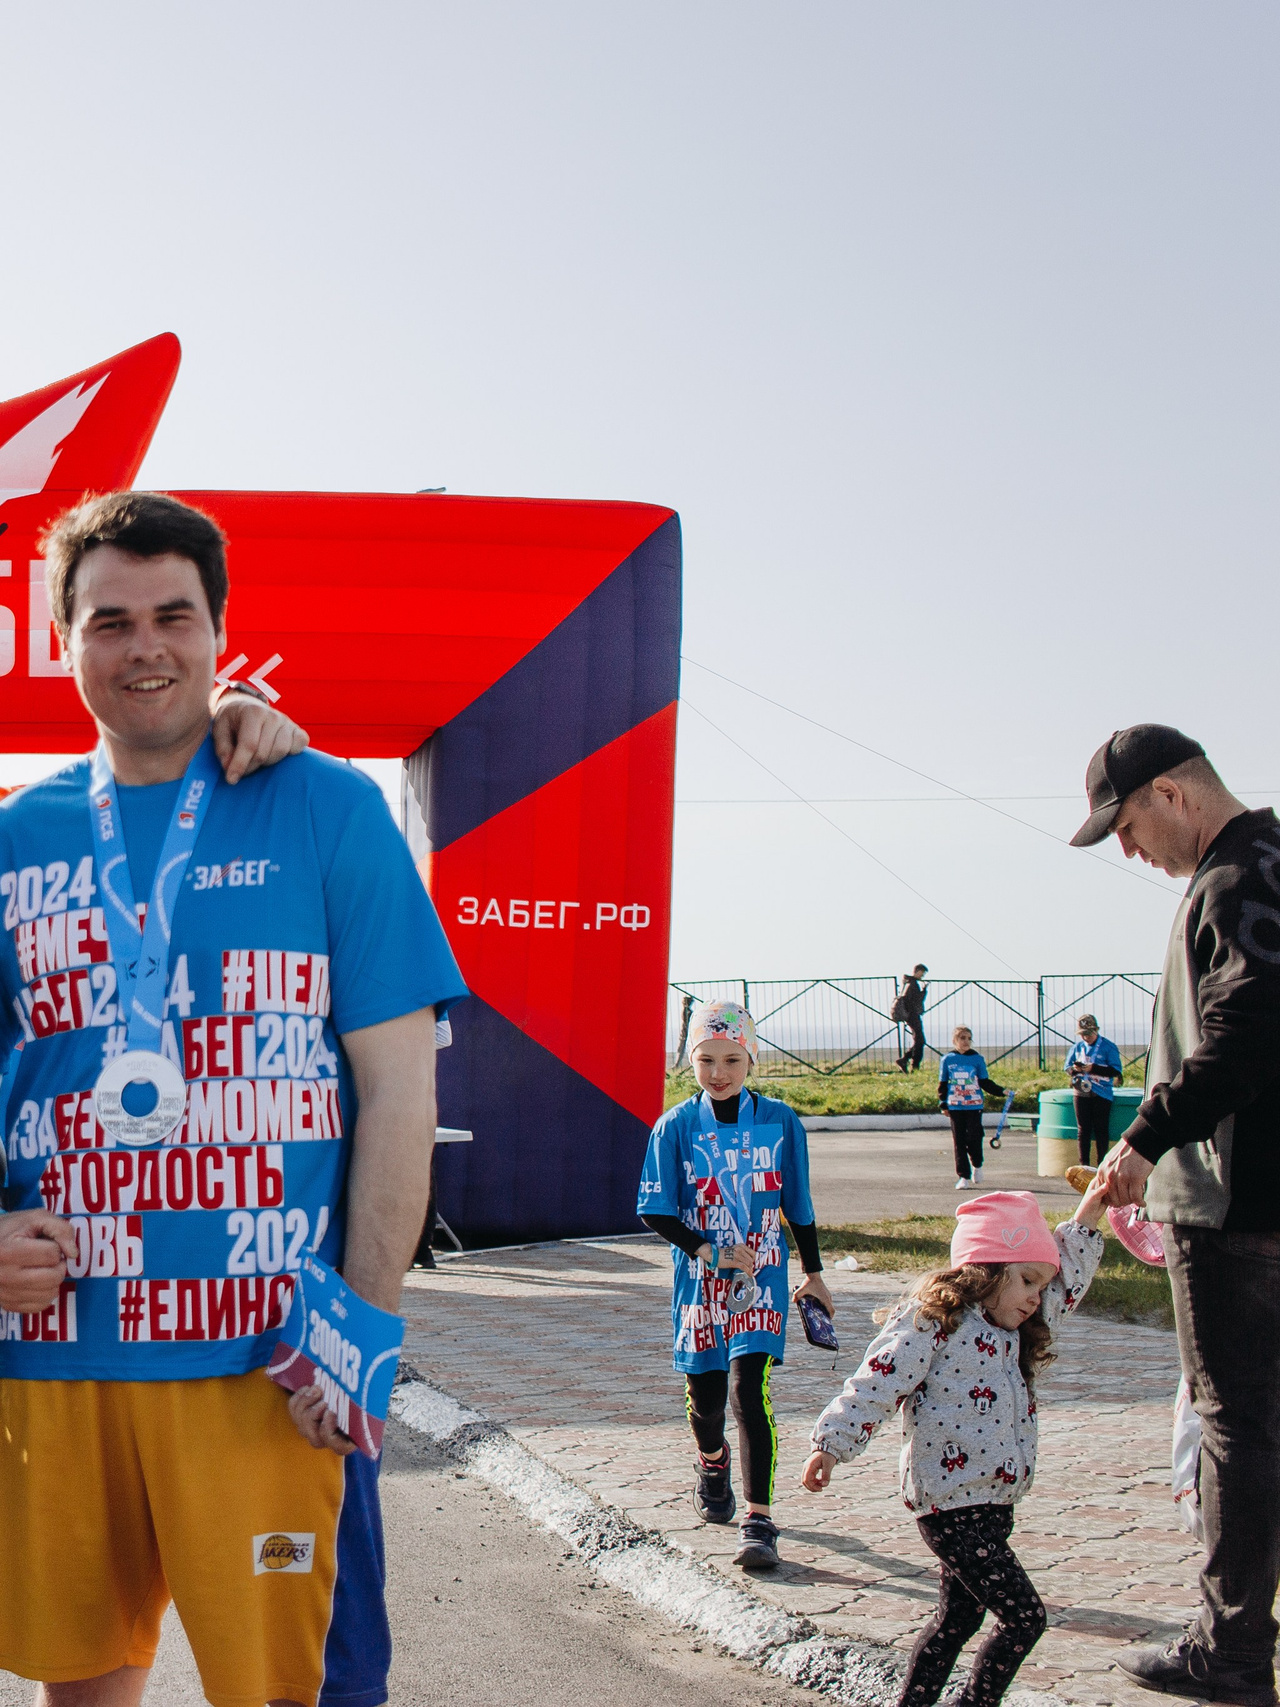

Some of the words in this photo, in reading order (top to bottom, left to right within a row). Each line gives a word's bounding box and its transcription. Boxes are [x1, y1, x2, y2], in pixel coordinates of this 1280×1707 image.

[185, 779, 206, 811] ПСБ
[99, 808, 115, 842] ПСБ
[0, 855, 97, 932] 2024
[457, 896, 651, 932] ЗАБЕГ.РФ
[39, 1145, 283, 1214] #ГОРДОСТЬ
[309, 1308, 362, 1393] 30013
